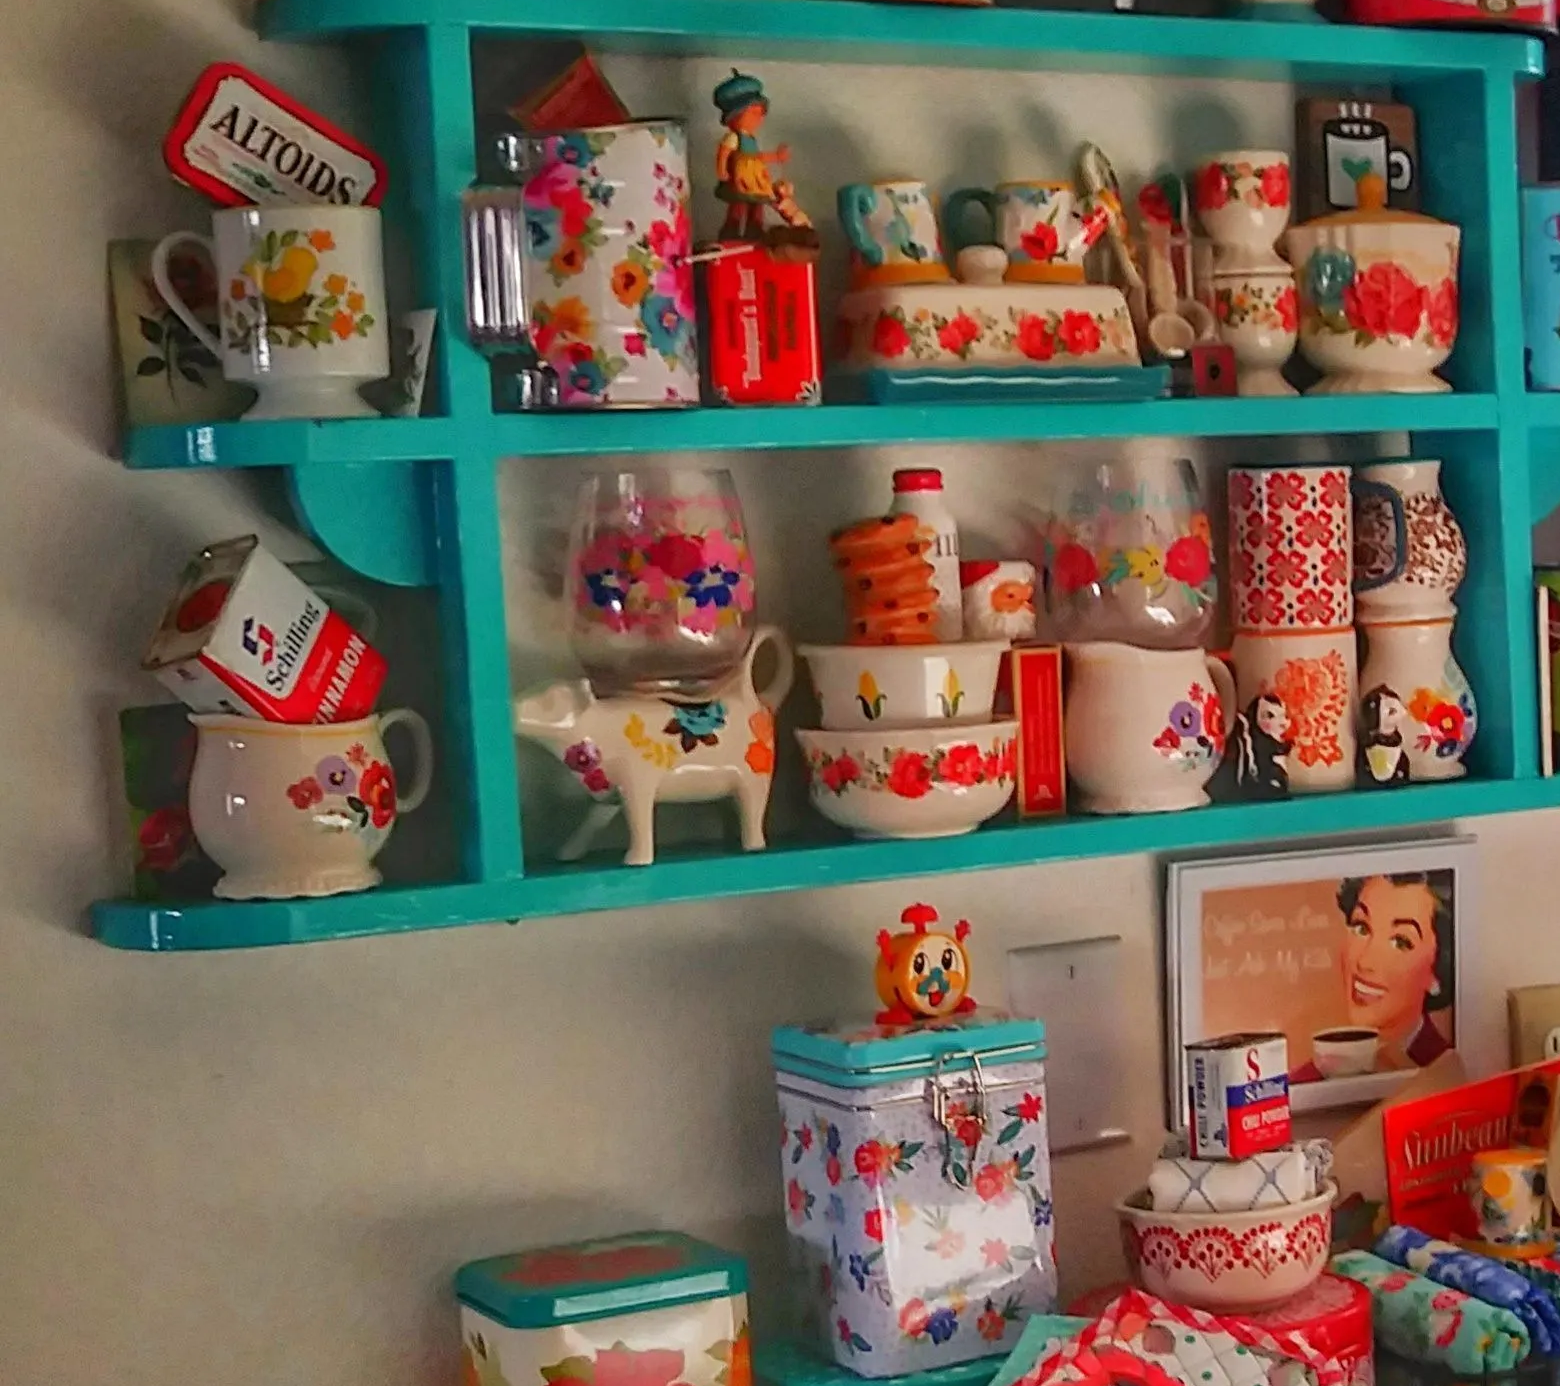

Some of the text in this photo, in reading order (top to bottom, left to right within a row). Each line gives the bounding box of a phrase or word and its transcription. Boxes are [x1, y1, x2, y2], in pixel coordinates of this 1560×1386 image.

[208, 102, 357, 205] ALTOIDS
[265, 599, 321, 692] Schilling
[312, 633, 369, 725] INNAMON
[1194, 1056, 1207, 1111] POWDER
